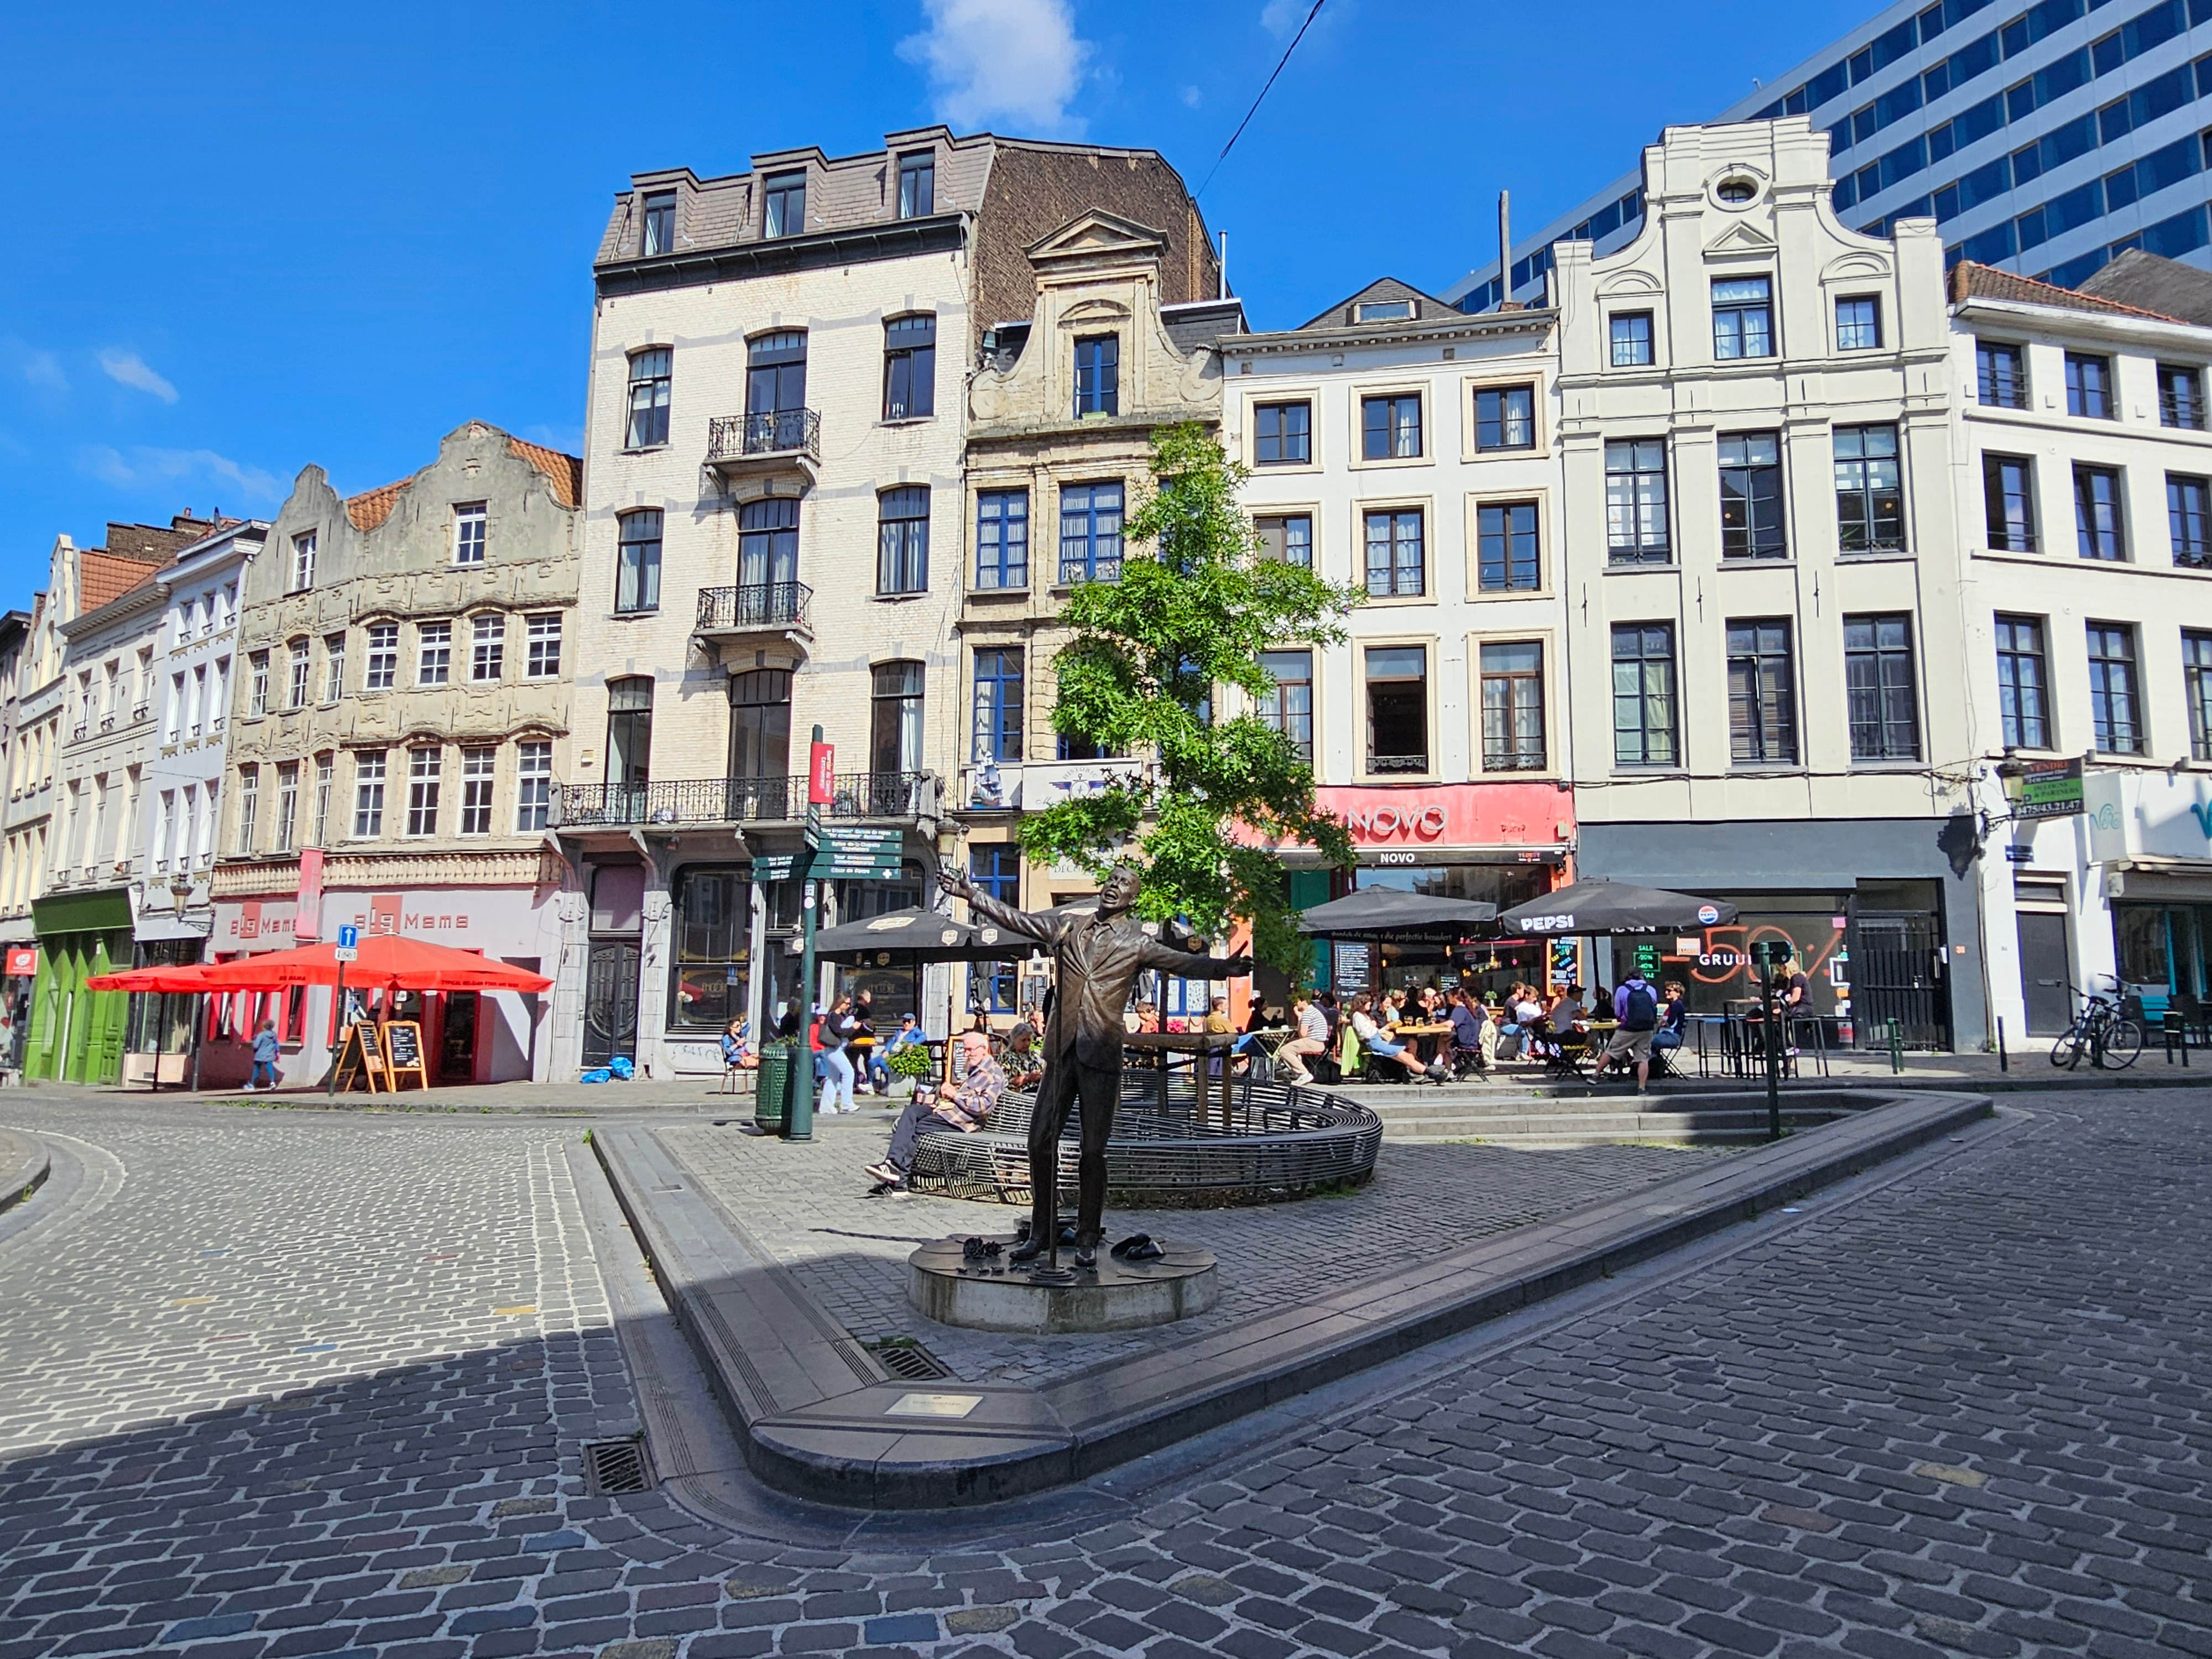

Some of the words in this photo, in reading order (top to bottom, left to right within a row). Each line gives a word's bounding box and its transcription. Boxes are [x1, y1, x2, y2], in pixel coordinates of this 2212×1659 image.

[1063, 766, 1098, 780] HISTORIC
[1348, 805, 1447, 831] NOVO
[1380, 853, 1415, 863] NOVO
[1521, 915, 1574, 931] PEPSI
